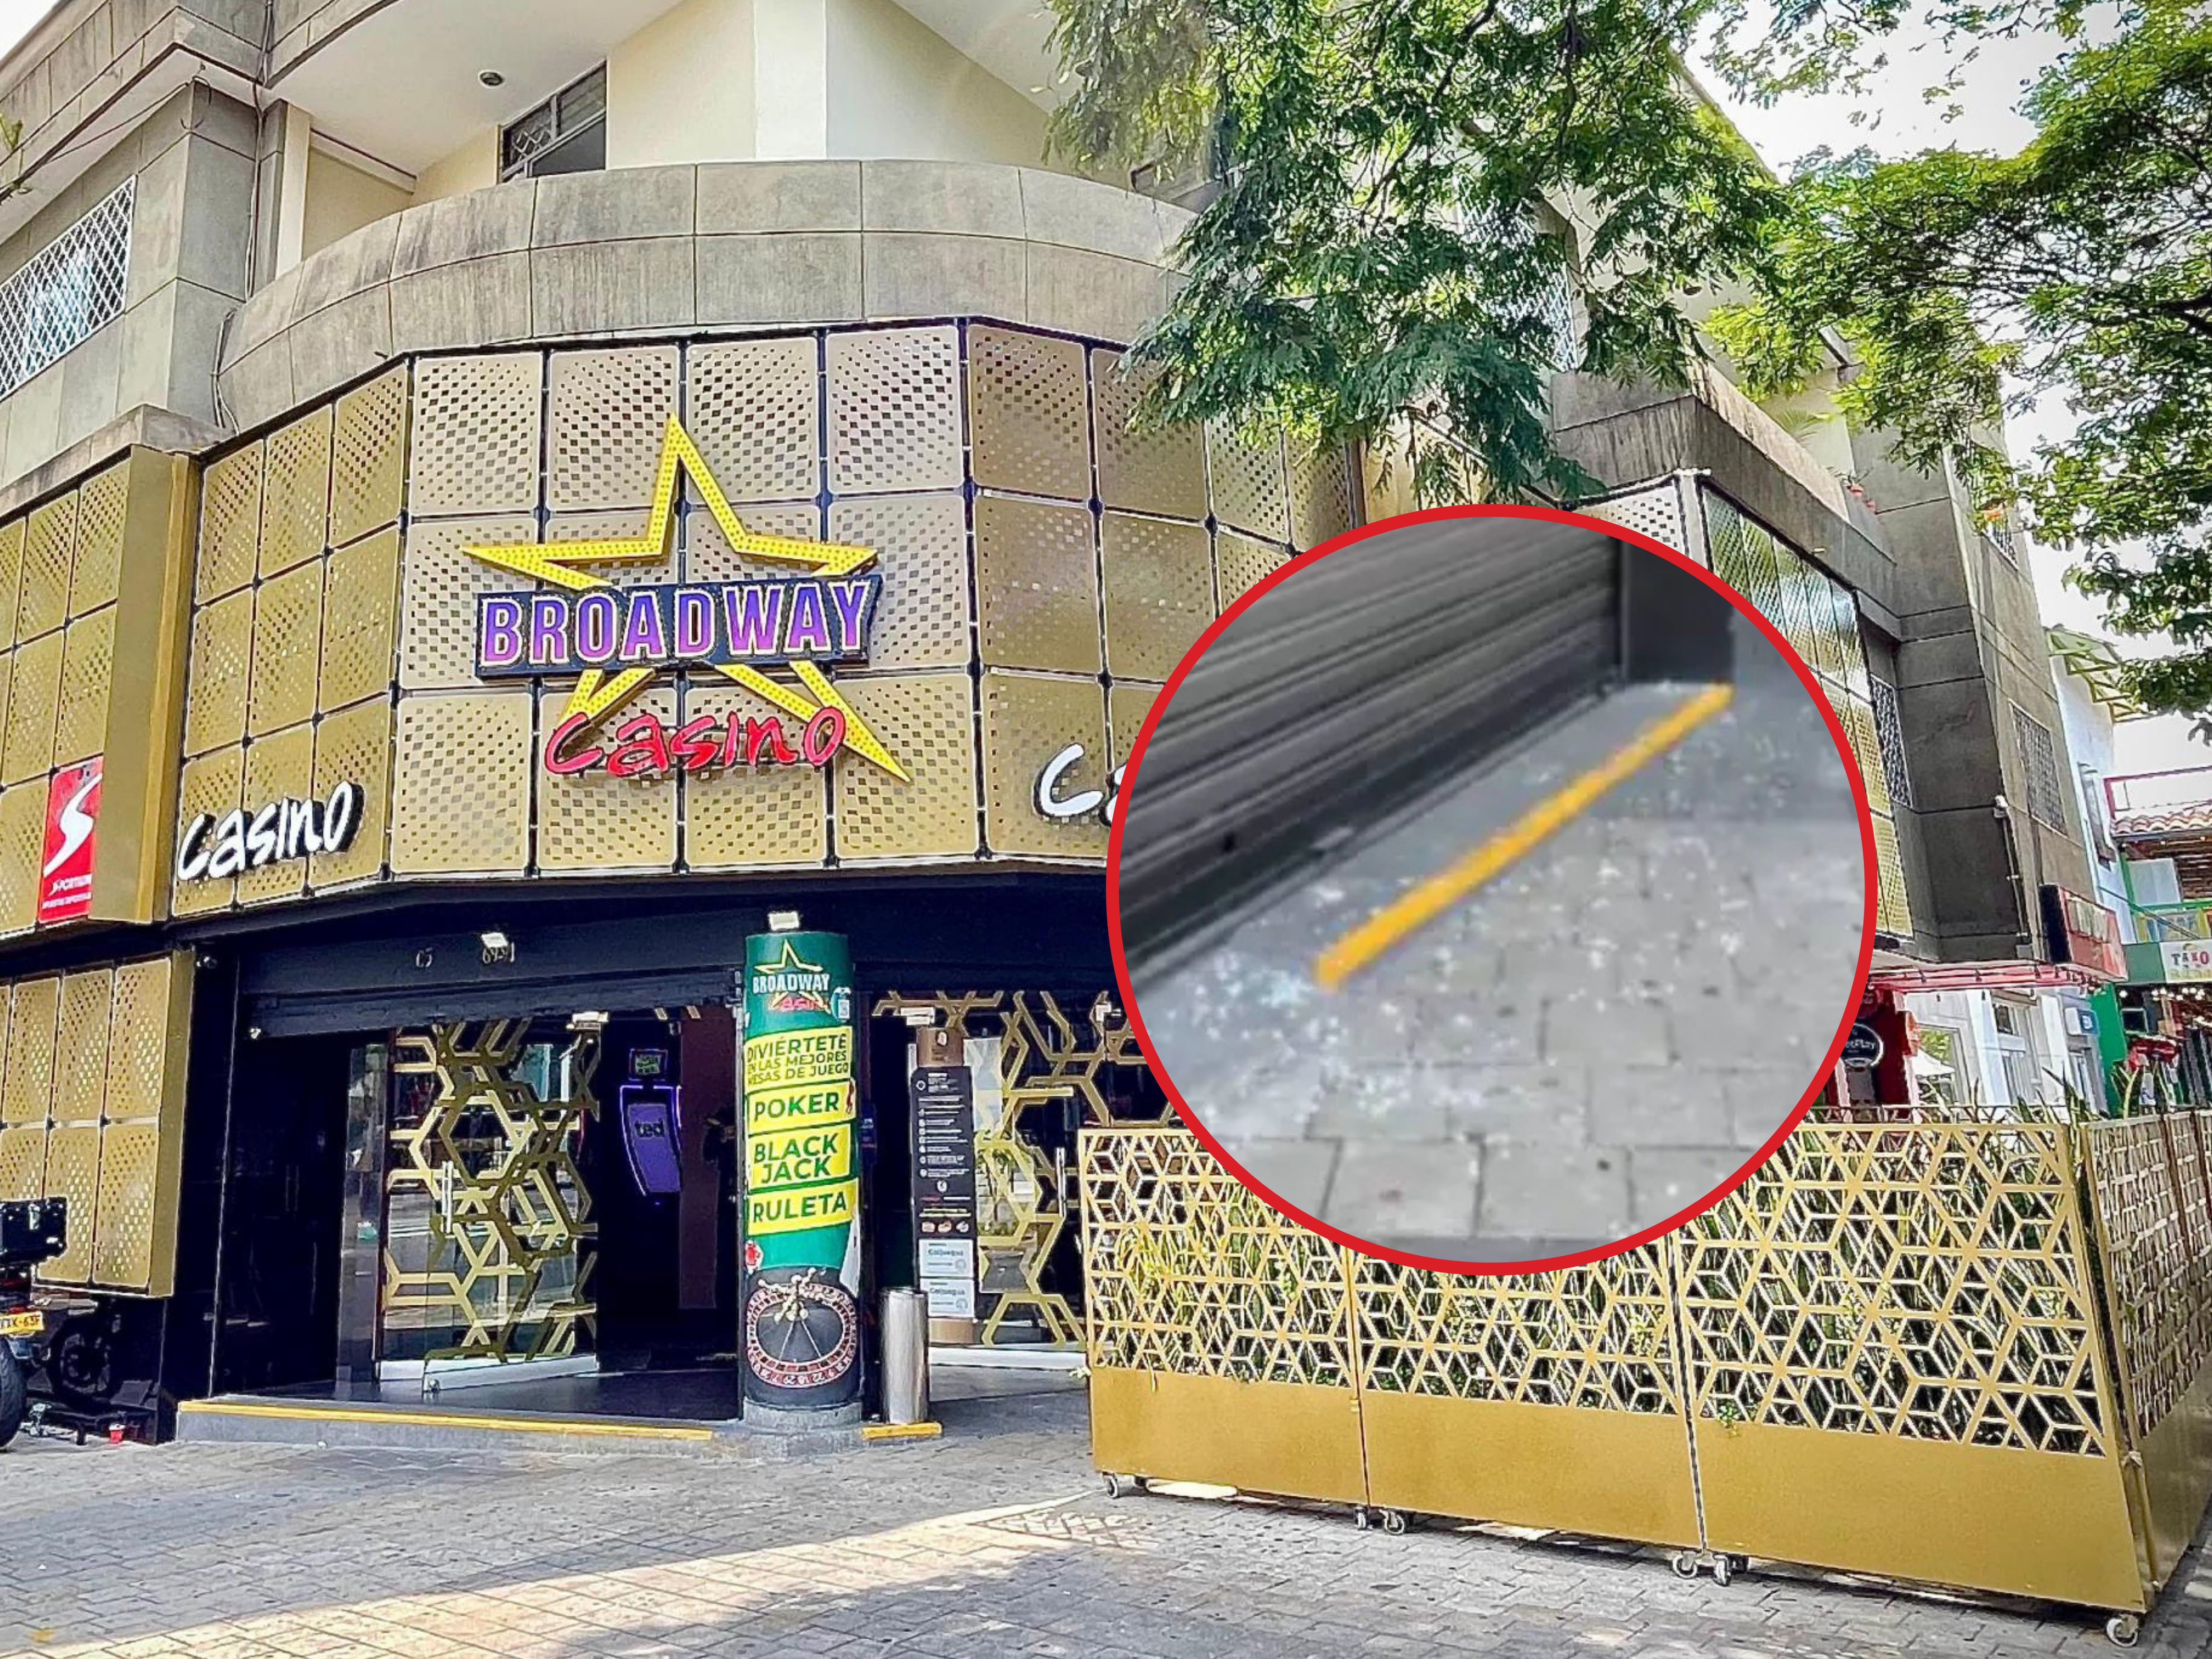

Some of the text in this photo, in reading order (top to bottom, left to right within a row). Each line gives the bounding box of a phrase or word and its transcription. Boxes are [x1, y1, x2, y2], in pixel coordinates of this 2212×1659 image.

[481, 580, 871, 666] BROADWAY
[544, 706, 846, 778] Casino
[176, 780, 361, 880] Casino
[753, 974, 830, 994] BROADWAY
[747, 1033, 847, 1062] DIVIÉRTETE
[758, 1058, 781, 1071] LAS
[786, 1050, 847, 1066] MEJORES
[785, 1067, 805, 1079] DE
[809, 1062, 849, 1076] JUEGO
[754, 1092, 839, 1121] POKER
[635, 1118, 665, 1137] ted
[754, 1133, 839, 1164] BLACK
[761, 1155, 831, 1184] JACK
[753, 1191, 847, 1223] RULETA
